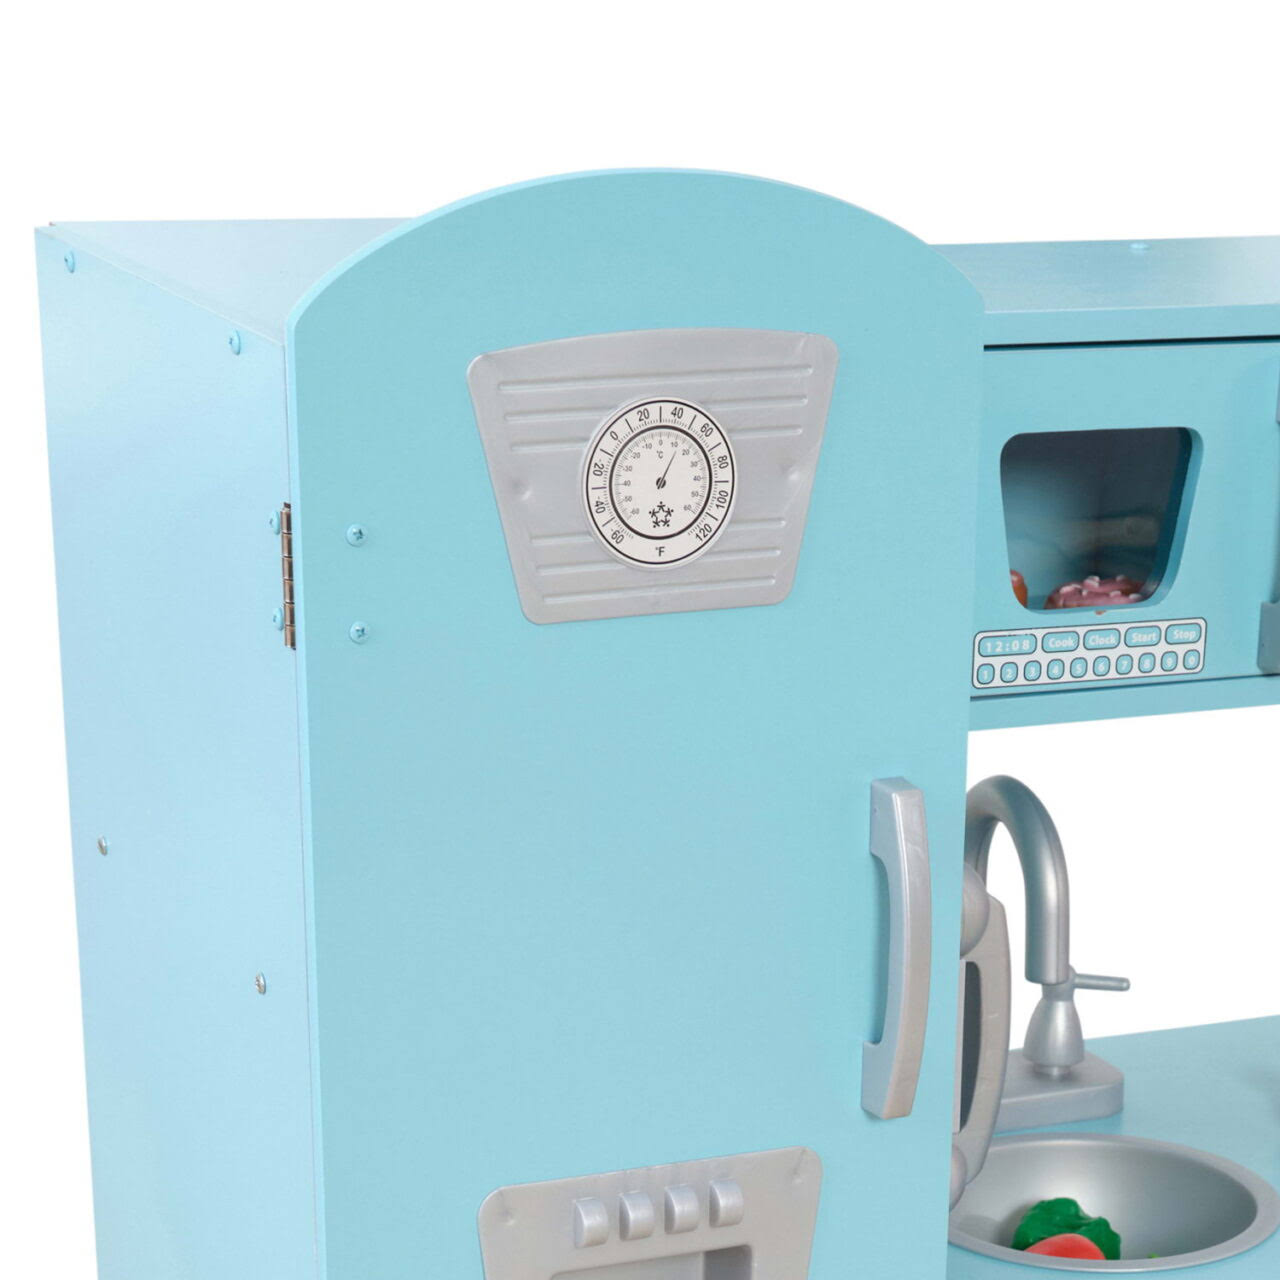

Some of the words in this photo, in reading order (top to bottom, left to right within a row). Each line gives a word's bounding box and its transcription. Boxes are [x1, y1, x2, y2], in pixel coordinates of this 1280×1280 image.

[637, 408, 650, 422] 20
[671, 407, 684, 419] 40
[610, 431, 619, 441] 0
[700, 423, 714, 437] 60
[717, 455, 729, 469] 80
[716, 490, 729, 509] 100
[695, 523, 713, 542] 120
[1048, 637, 1074, 648] Cook
[1088, 634, 1115, 645] Clock
[1132, 631, 1157, 643] Start
[1173, 629, 1196, 640] Stop
